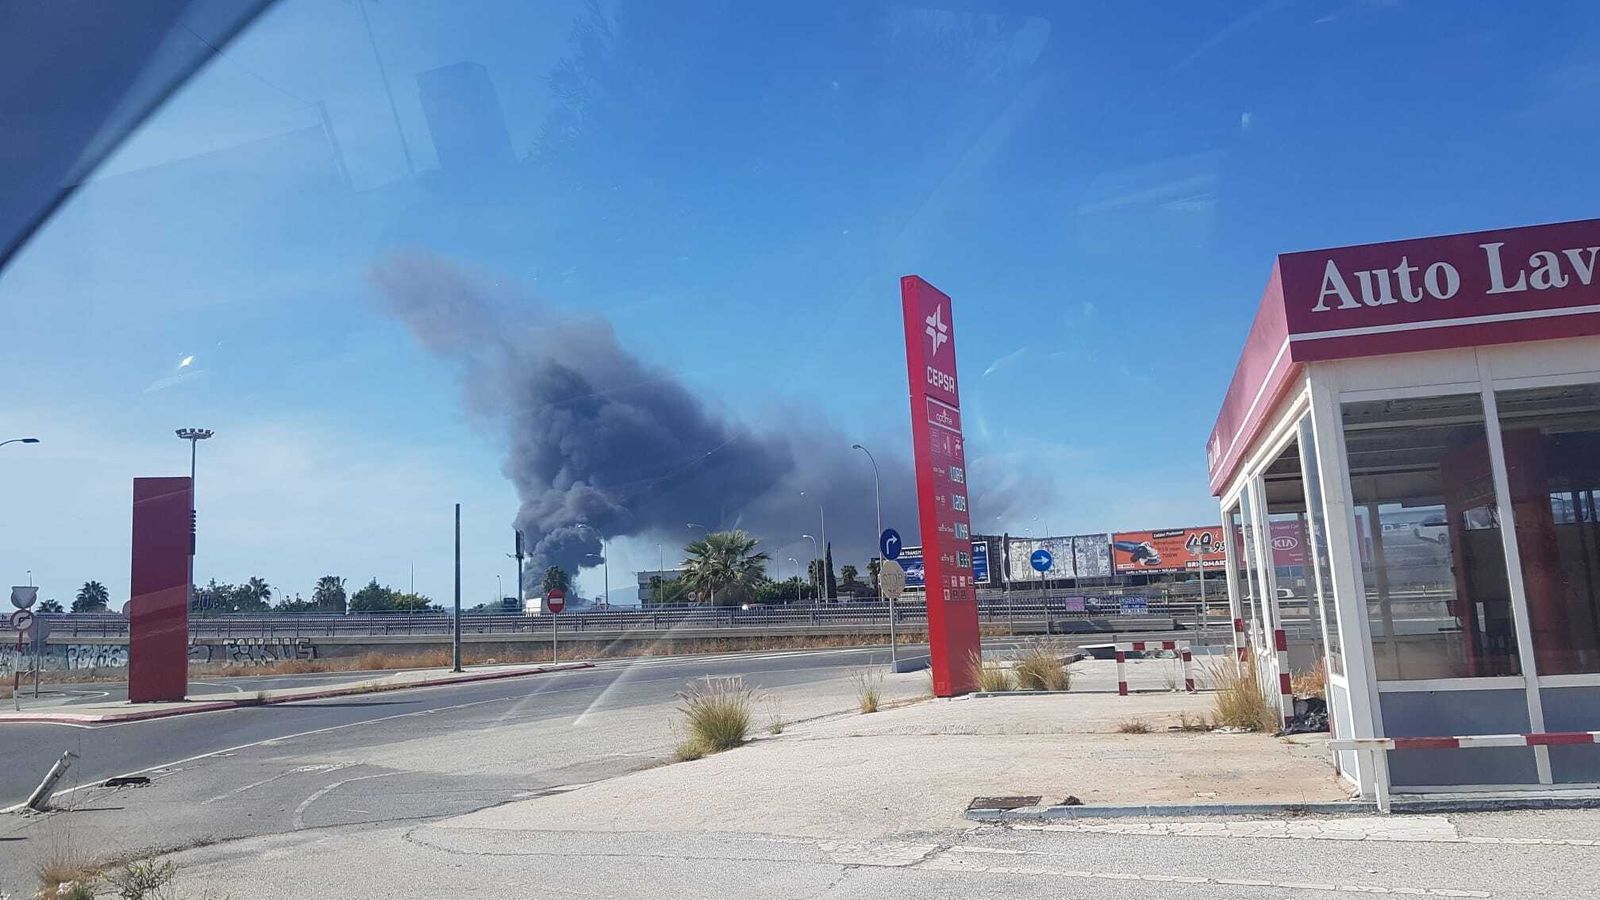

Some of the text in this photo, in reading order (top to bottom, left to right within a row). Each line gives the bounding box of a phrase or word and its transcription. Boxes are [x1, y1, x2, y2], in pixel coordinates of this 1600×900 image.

[1311, 241, 1600, 312] Auto Lav
[927, 365, 955, 395] CEPSA
[1274, 538, 1293, 548] KIA
